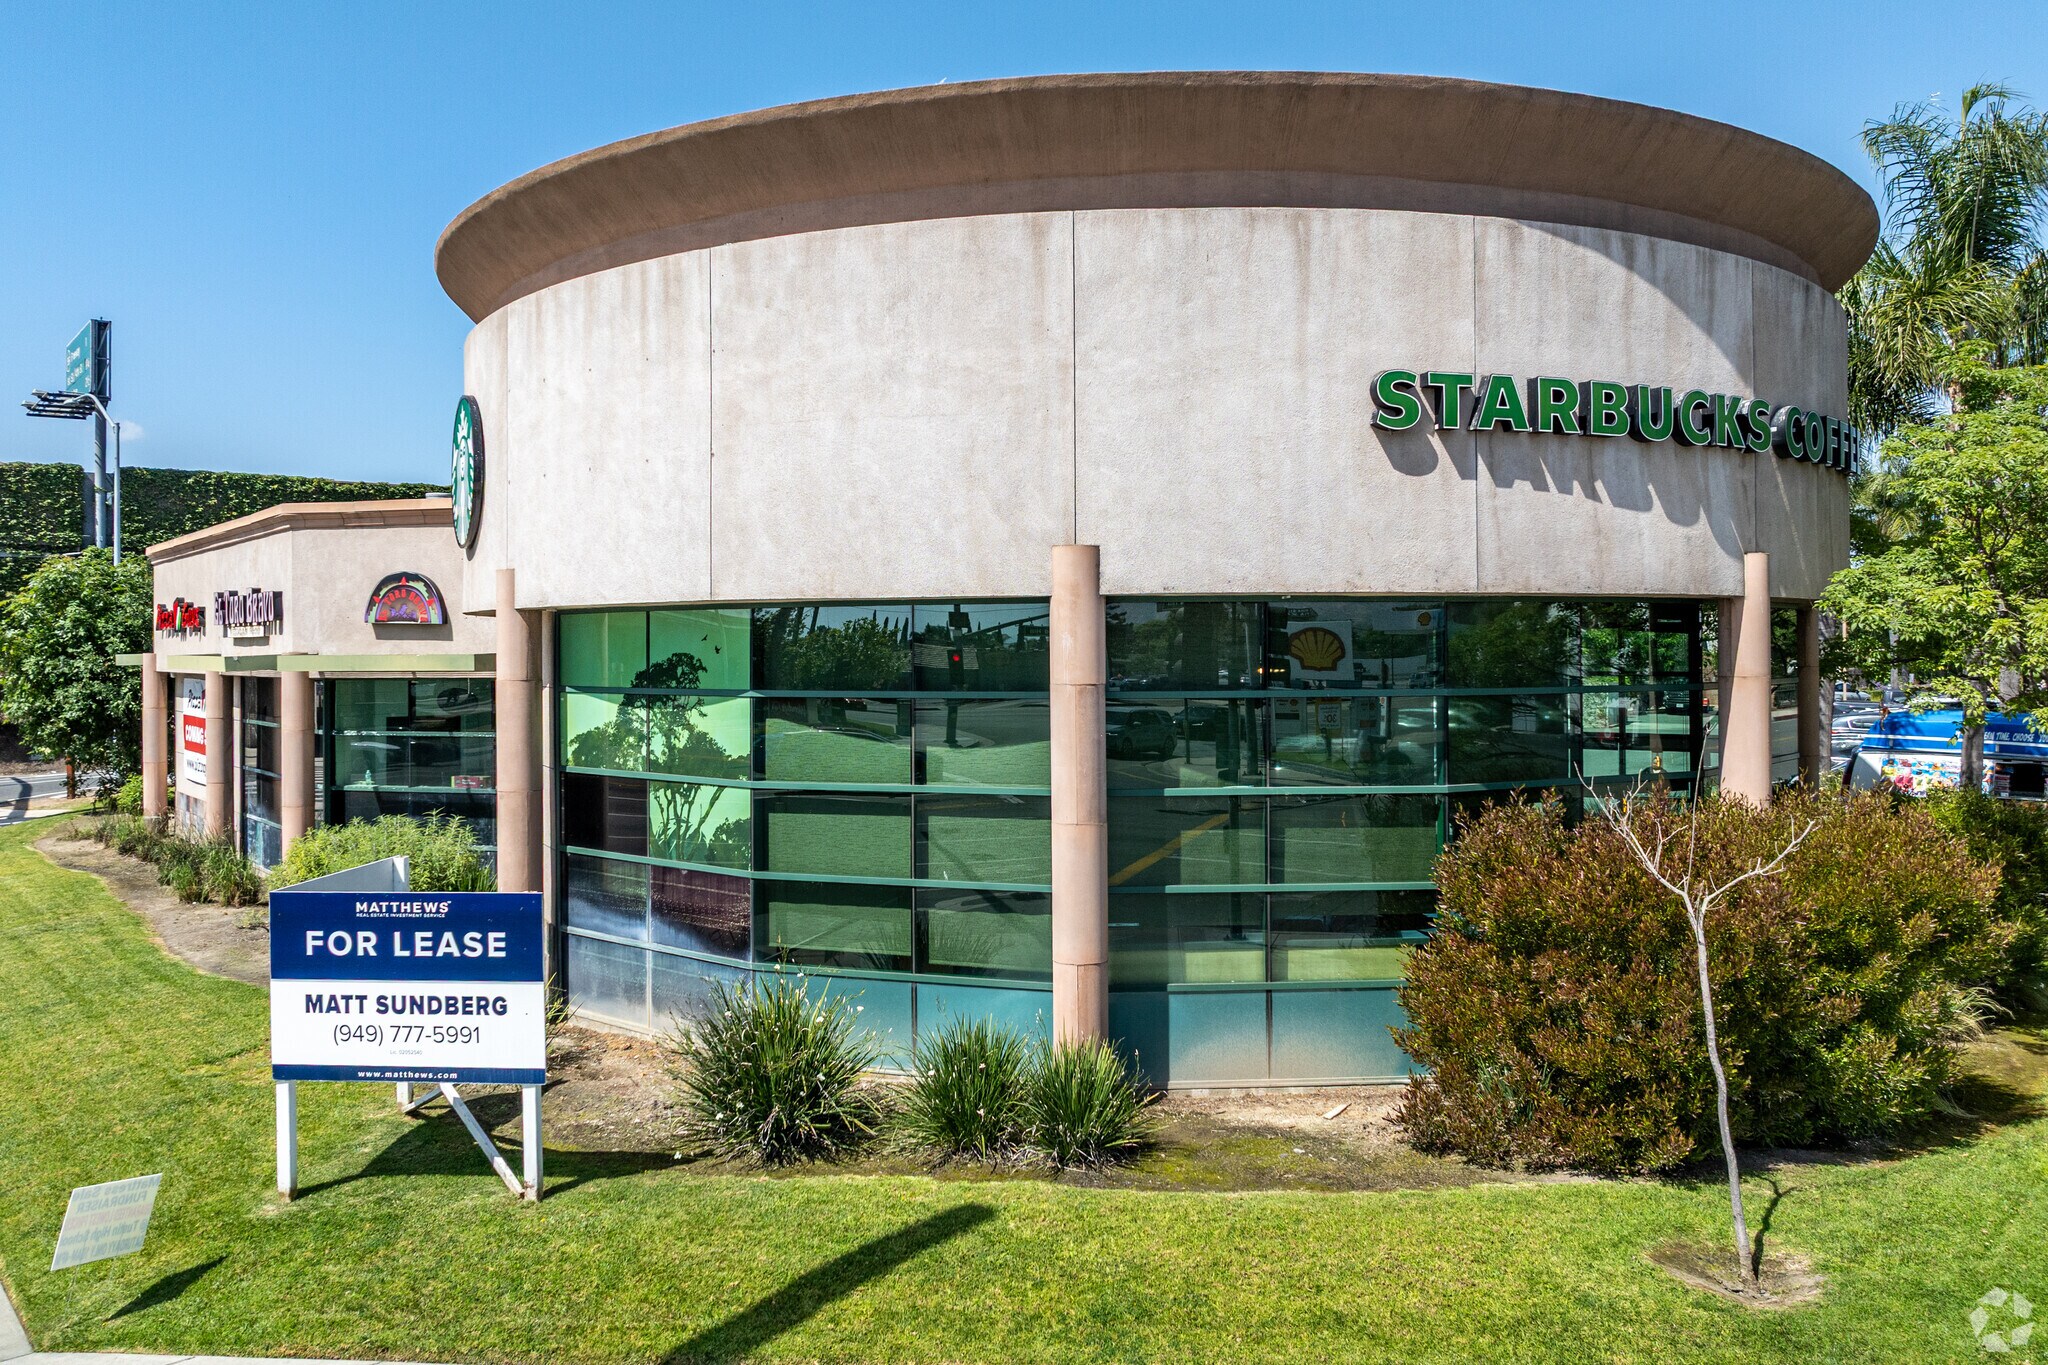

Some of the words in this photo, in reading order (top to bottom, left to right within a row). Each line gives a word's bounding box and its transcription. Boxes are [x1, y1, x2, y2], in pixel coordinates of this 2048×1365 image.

[1371, 369, 1772, 453] STARBUCKS
[384, 589, 407, 606] TORO
[185, 724, 204, 745] COMING
[355, 901, 449, 913] MATTHEWS
[305, 930, 377, 957] FOR
[393, 931, 507, 958] LEASE
[305, 994, 368, 1015] MATT
[376, 995, 508, 1016] SUNDBERG
[333, 1024, 384, 1047] (949)
[390, 1025, 481, 1044] 777-5991
[357, 1070, 458, 1080] www.matthews.com
